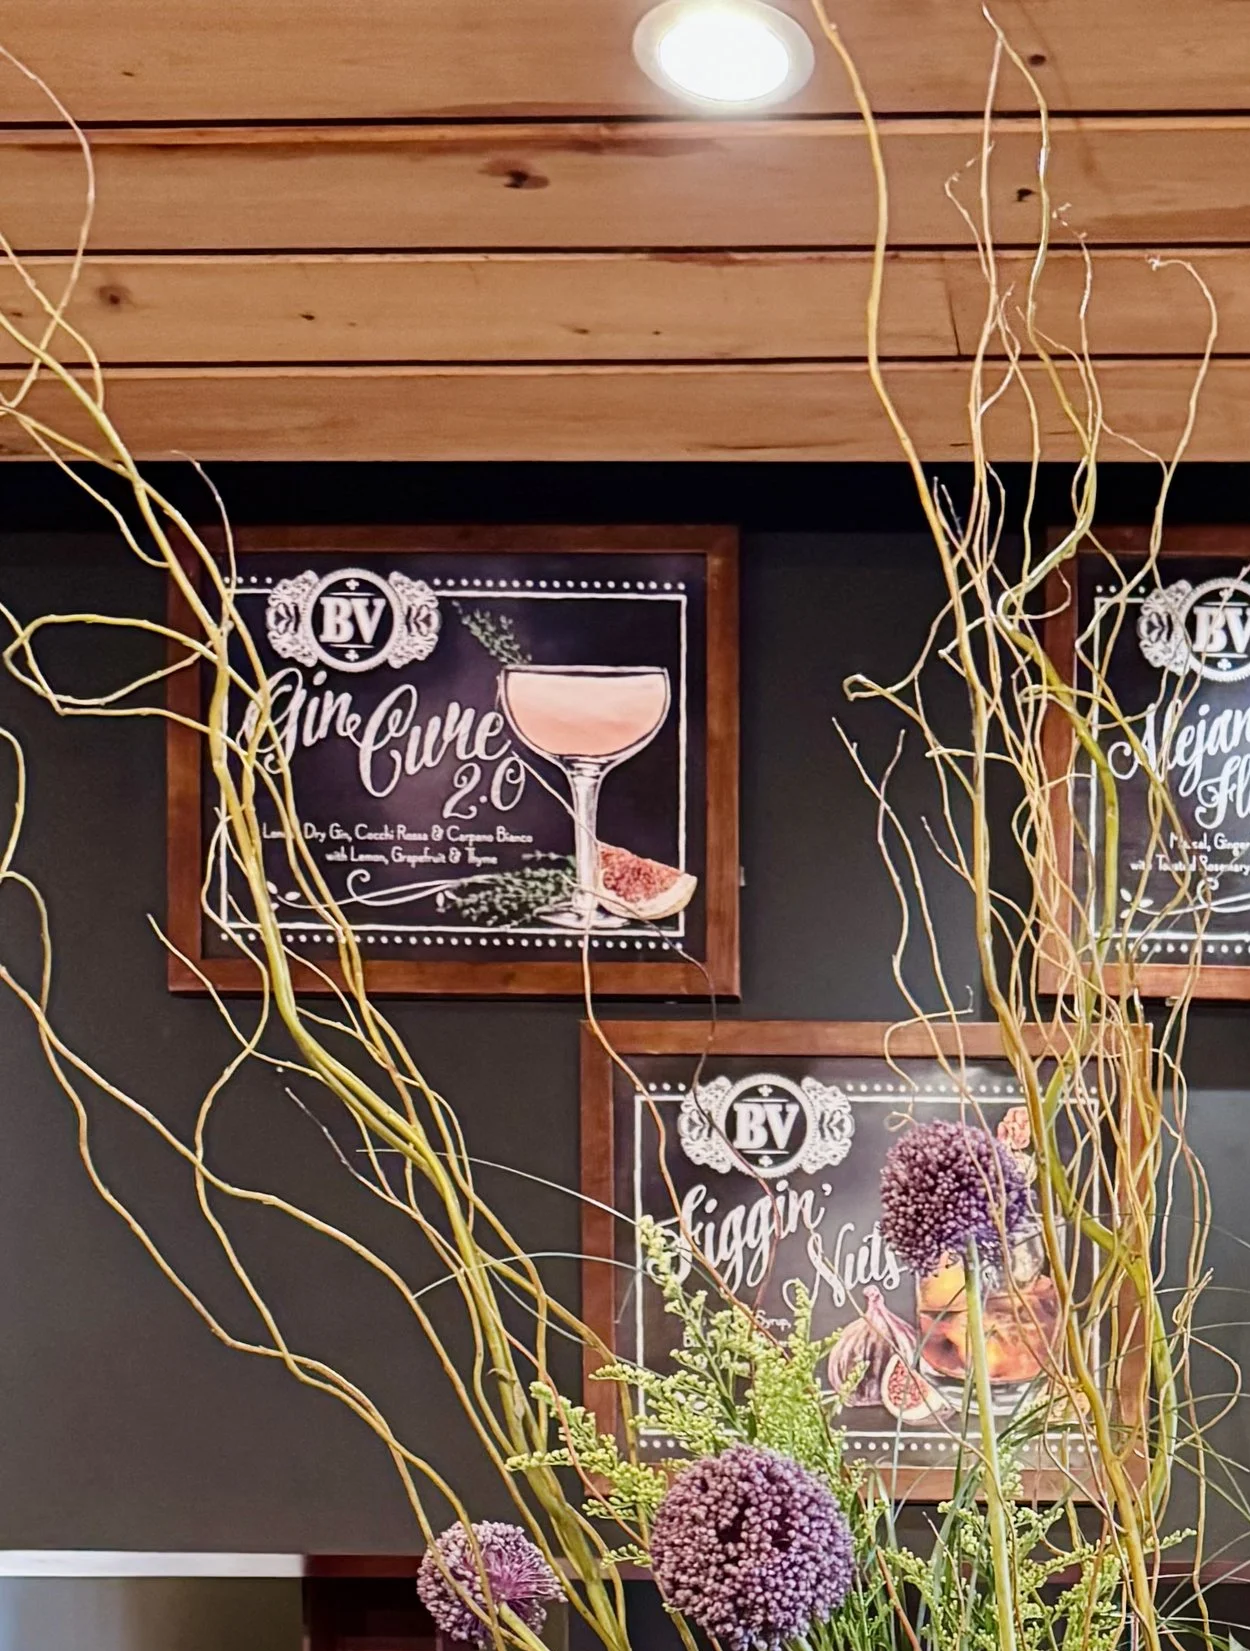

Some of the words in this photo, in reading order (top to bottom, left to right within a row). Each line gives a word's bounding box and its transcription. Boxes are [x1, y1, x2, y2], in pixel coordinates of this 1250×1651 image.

[319, 597, 386, 643] BV
[236, 668, 358, 774] Gin
[359, 684, 511, 797] Cure
[442, 757, 526, 818] 2.0
[303, 822, 326, 843] Dry
[329, 822, 353, 843] Gin,
[355, 824, 395, 841] Cocchi
[431, 824, 444, 841] &
[446, 825, 495, 846] Carpano
[496, 826, 534, 843] Bianco
[325, 846, 348, 861] with
[350, 846, 389, 865] Lemon,
[391, 846, 446, 868] Grapefruit
[448, 847, 461, 864] &
[465, 847, 498, 867] Thyme
[1213, 832, 1250, 857] Ginger
[732, 1102, 799, 1150] BV
[782, 1221, 908, 1310] Nuts
